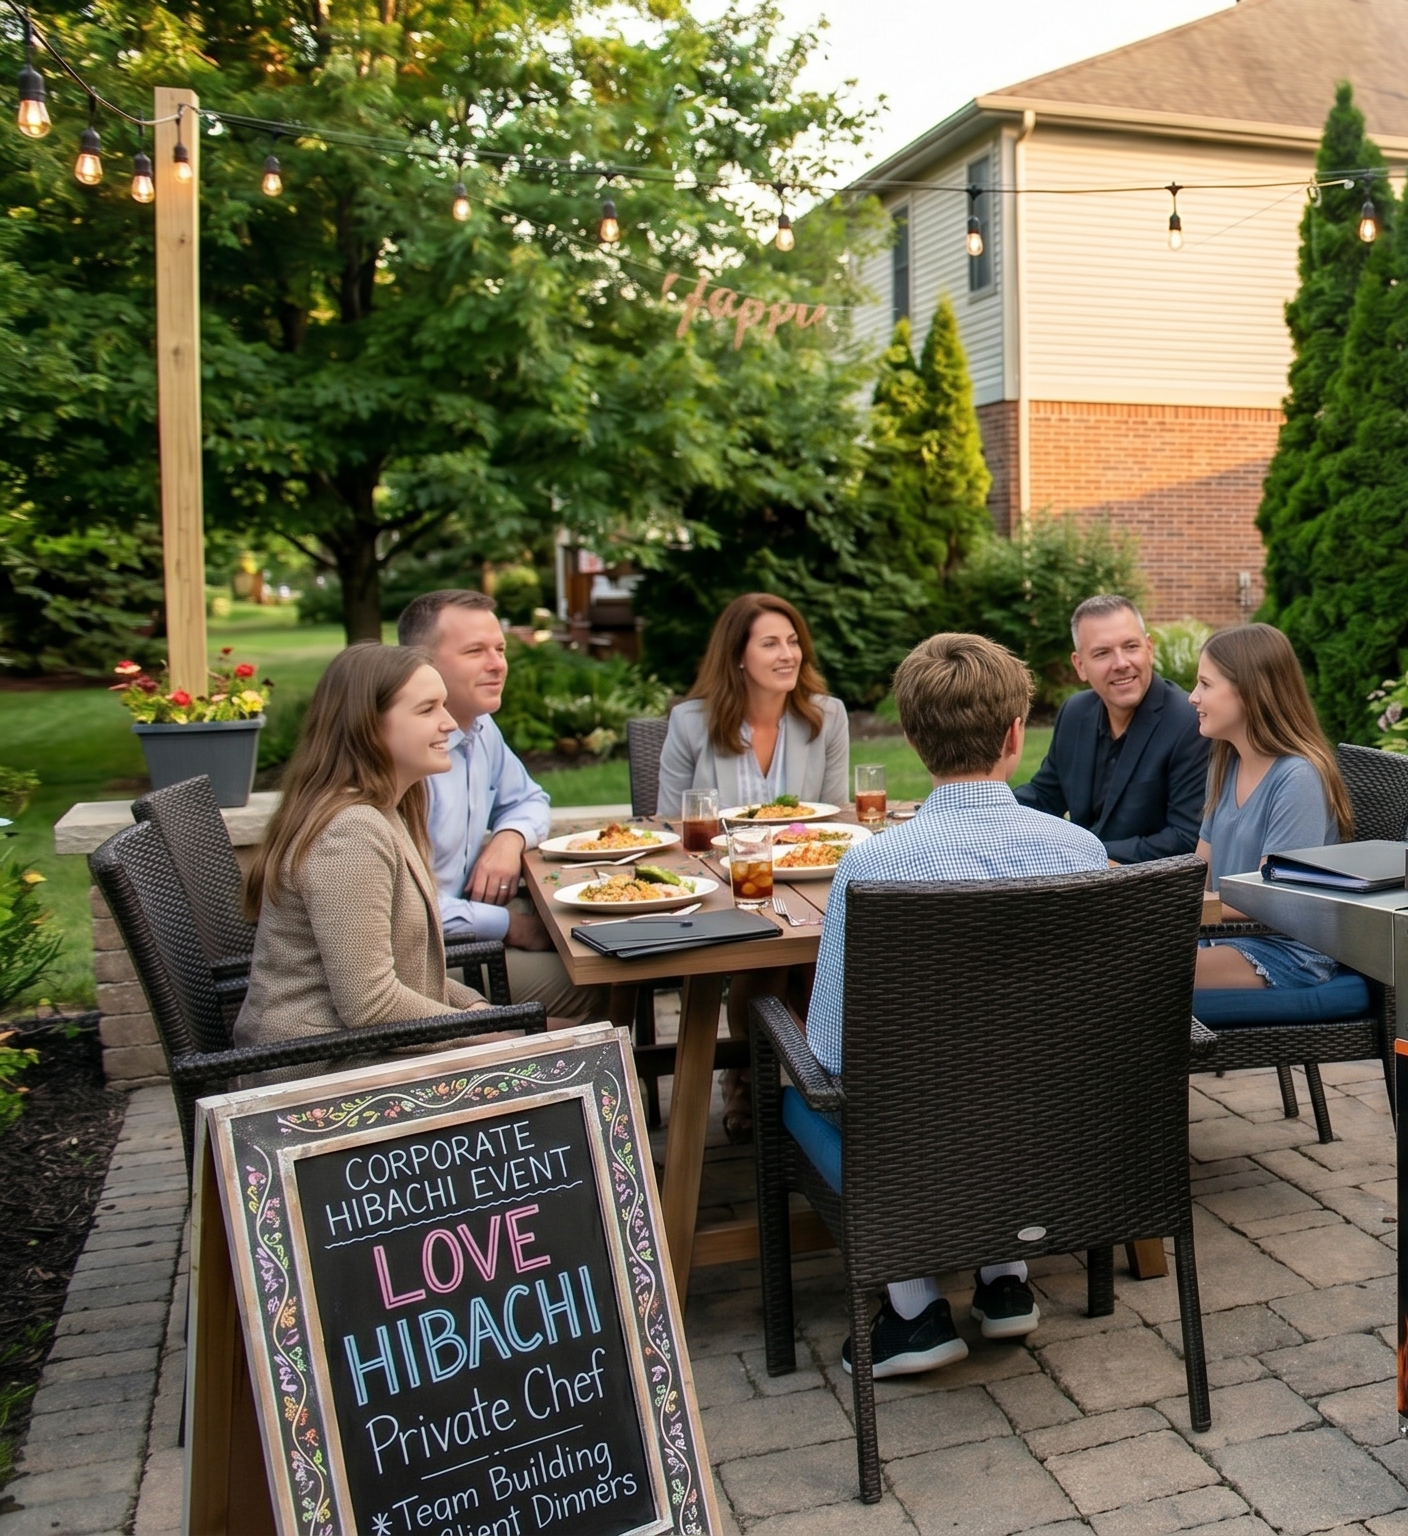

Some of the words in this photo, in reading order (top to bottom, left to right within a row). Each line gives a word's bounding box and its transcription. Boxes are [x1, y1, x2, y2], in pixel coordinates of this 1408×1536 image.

[324, 1175, 458, 1236] HIBACHI
[470, 1145, 571, 1200] EVENT
[345, 1120, 536, 1191] CORPORATE
[373, 1203, 552, 1310] LOVE
[343, 1265, 602, 1407] HIBACHI
[365, 1387, 517, 1475] Private
[524, 1347, 606, 1420] Chef
[391, 1488, 479, 1531] Team
[488, 1442, 613, 1501] Building
[531, 1473, 638, 1529] Dinners
